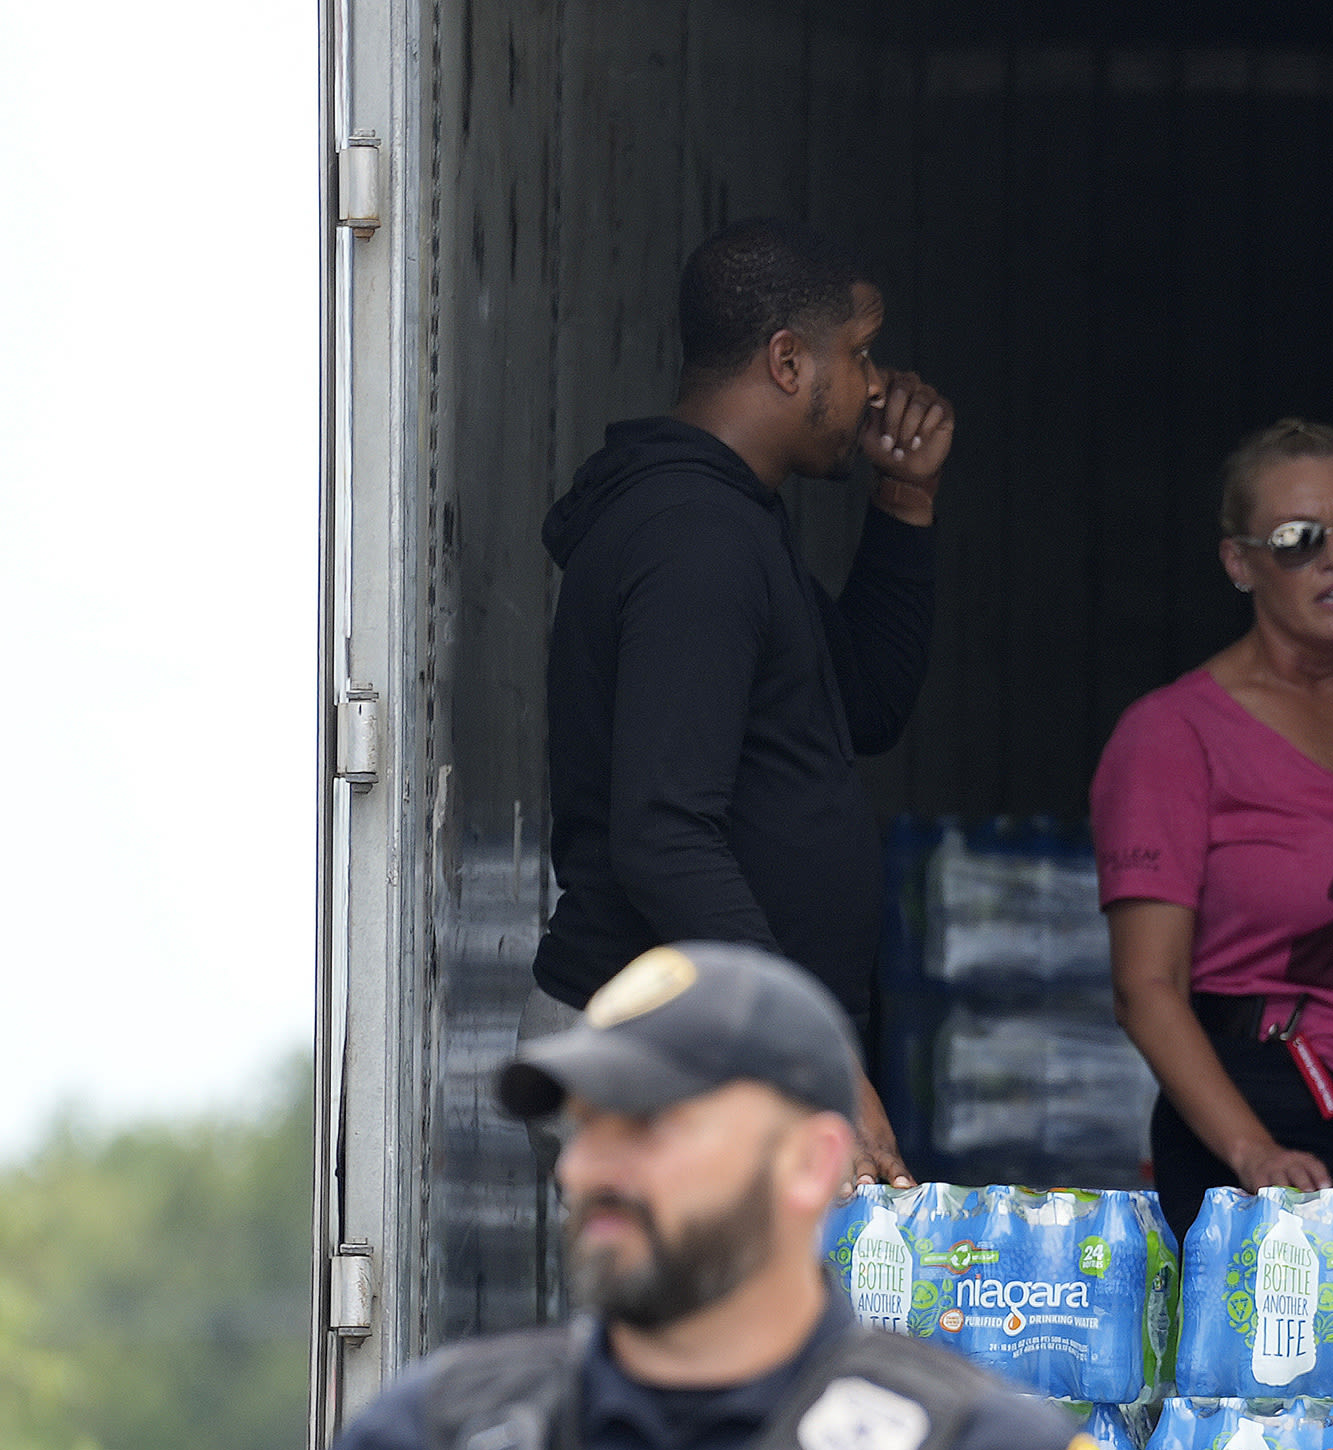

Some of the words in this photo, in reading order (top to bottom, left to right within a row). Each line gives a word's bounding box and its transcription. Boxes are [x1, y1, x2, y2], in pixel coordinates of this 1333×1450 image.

[857, 1238, 882, 1258] GIVE
[884, 1241, 906, 1263] THIS
[1083, 1245, 1104, 1261] 24
[1263, 1240, 1288, 1261] GIVE
[1289, 1245, 1311, 1267] THIS
[857, 1262, 905, 1293] BOTTLE
[1263, 1266, 1310, 1296] BOTTLE
[858, 1293, 903, 1314] ANOTHER
[957, 1274, 1089, 1336] niagara
[1262, 1295, 1308, 1316] ANOTHER
[965, 1316, 1002, 1328] PURIFIED
[1029, 1315, 1073, 1327] DRINKING
[1074, 1316, 1099, 1329] WATER
[1263, 1319, 1307, 1357] LIFE
